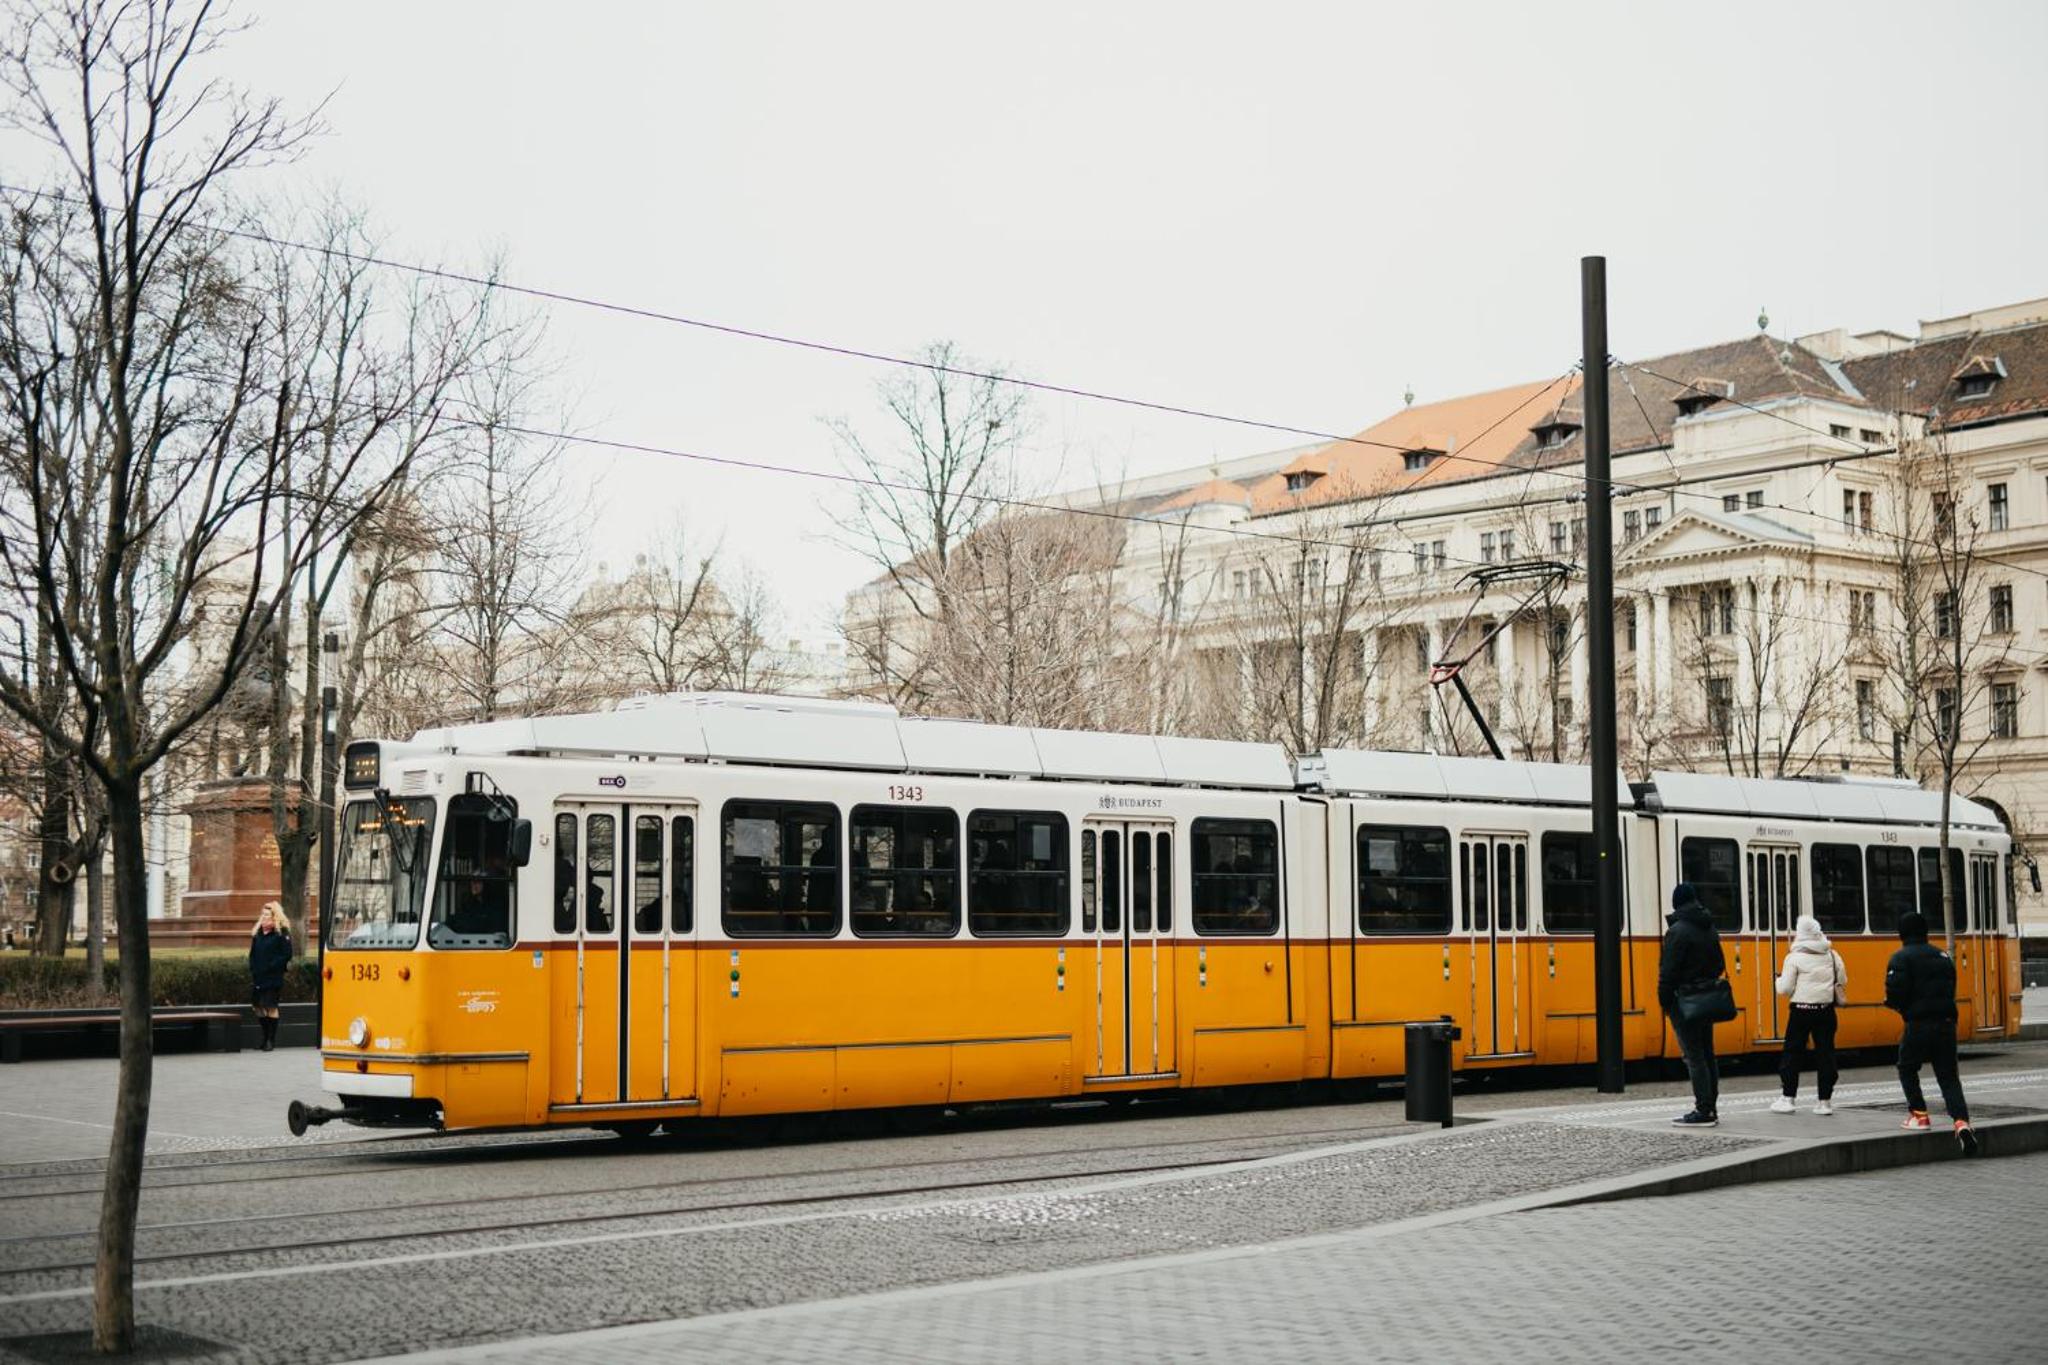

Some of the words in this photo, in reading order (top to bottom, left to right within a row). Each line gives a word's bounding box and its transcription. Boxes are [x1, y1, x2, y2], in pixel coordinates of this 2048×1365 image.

[888, 785, 923, 801] 1343
[1118, 798, 1163, 808] BUDAPEST
[351, 963, 380, 981] 1343
